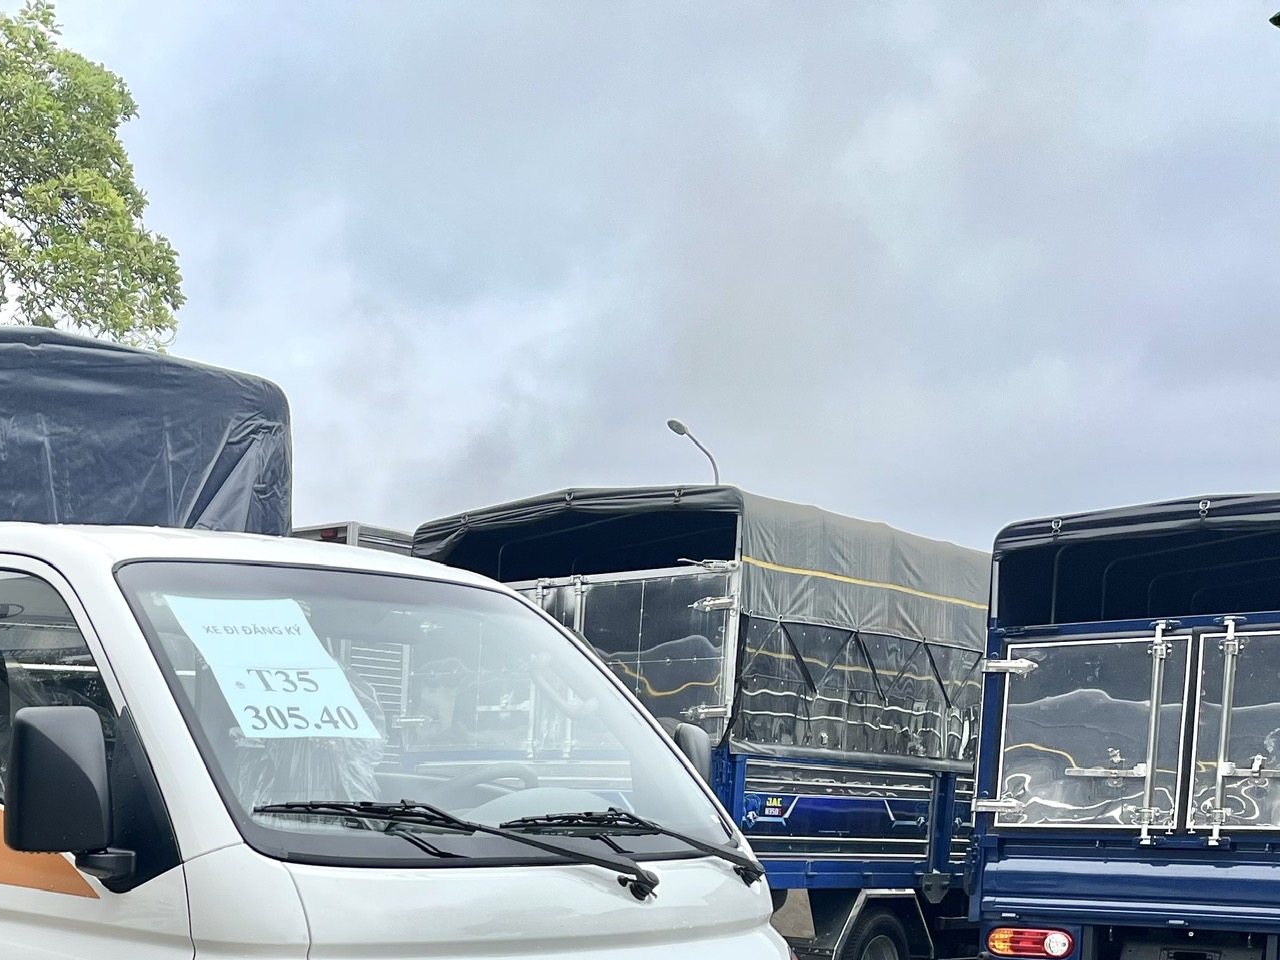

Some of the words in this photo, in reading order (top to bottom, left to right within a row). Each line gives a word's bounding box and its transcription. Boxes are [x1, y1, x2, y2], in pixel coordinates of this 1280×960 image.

[202, 625, 223, 636] XE
[223, 625, 240, 636] ĐI
[241, 623, 284, 636] ĐĂNG
[285, 624, 302, 636] KÝ
[246, 668, 319, 693] T35
[243, 705, 359, 731] 305.40
[766, 797, 783, 807] JAC
